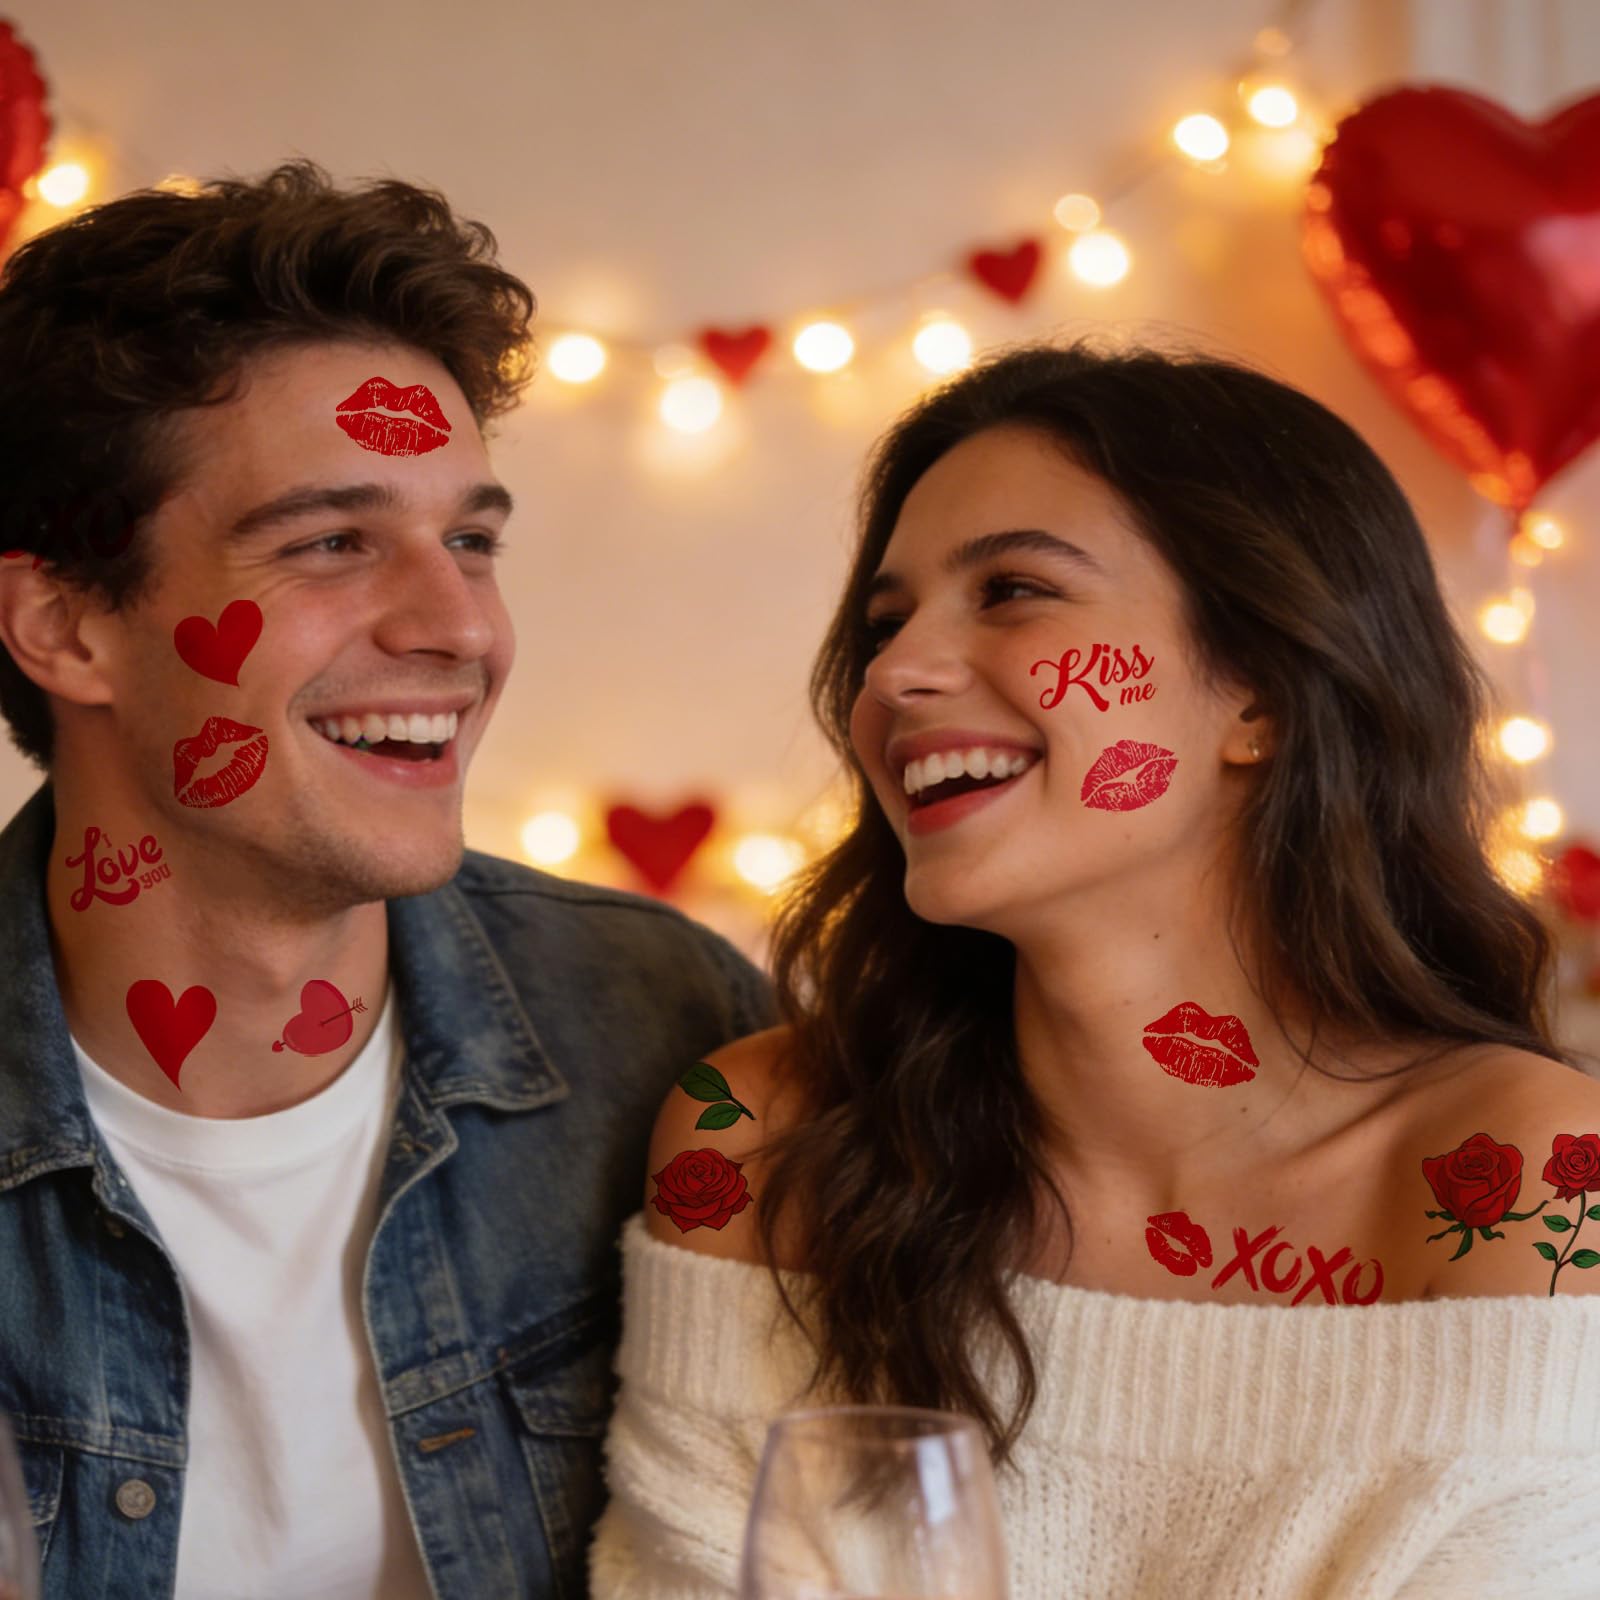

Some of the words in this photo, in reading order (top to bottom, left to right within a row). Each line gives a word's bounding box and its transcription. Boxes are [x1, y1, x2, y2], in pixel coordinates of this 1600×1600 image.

[1030, 643, 1155, 712] Kiss
[1119, 682, 1157, 706] me
[65, 826, 163, 913] Love
[1211, 1225, 1385, 1307] XOXO
